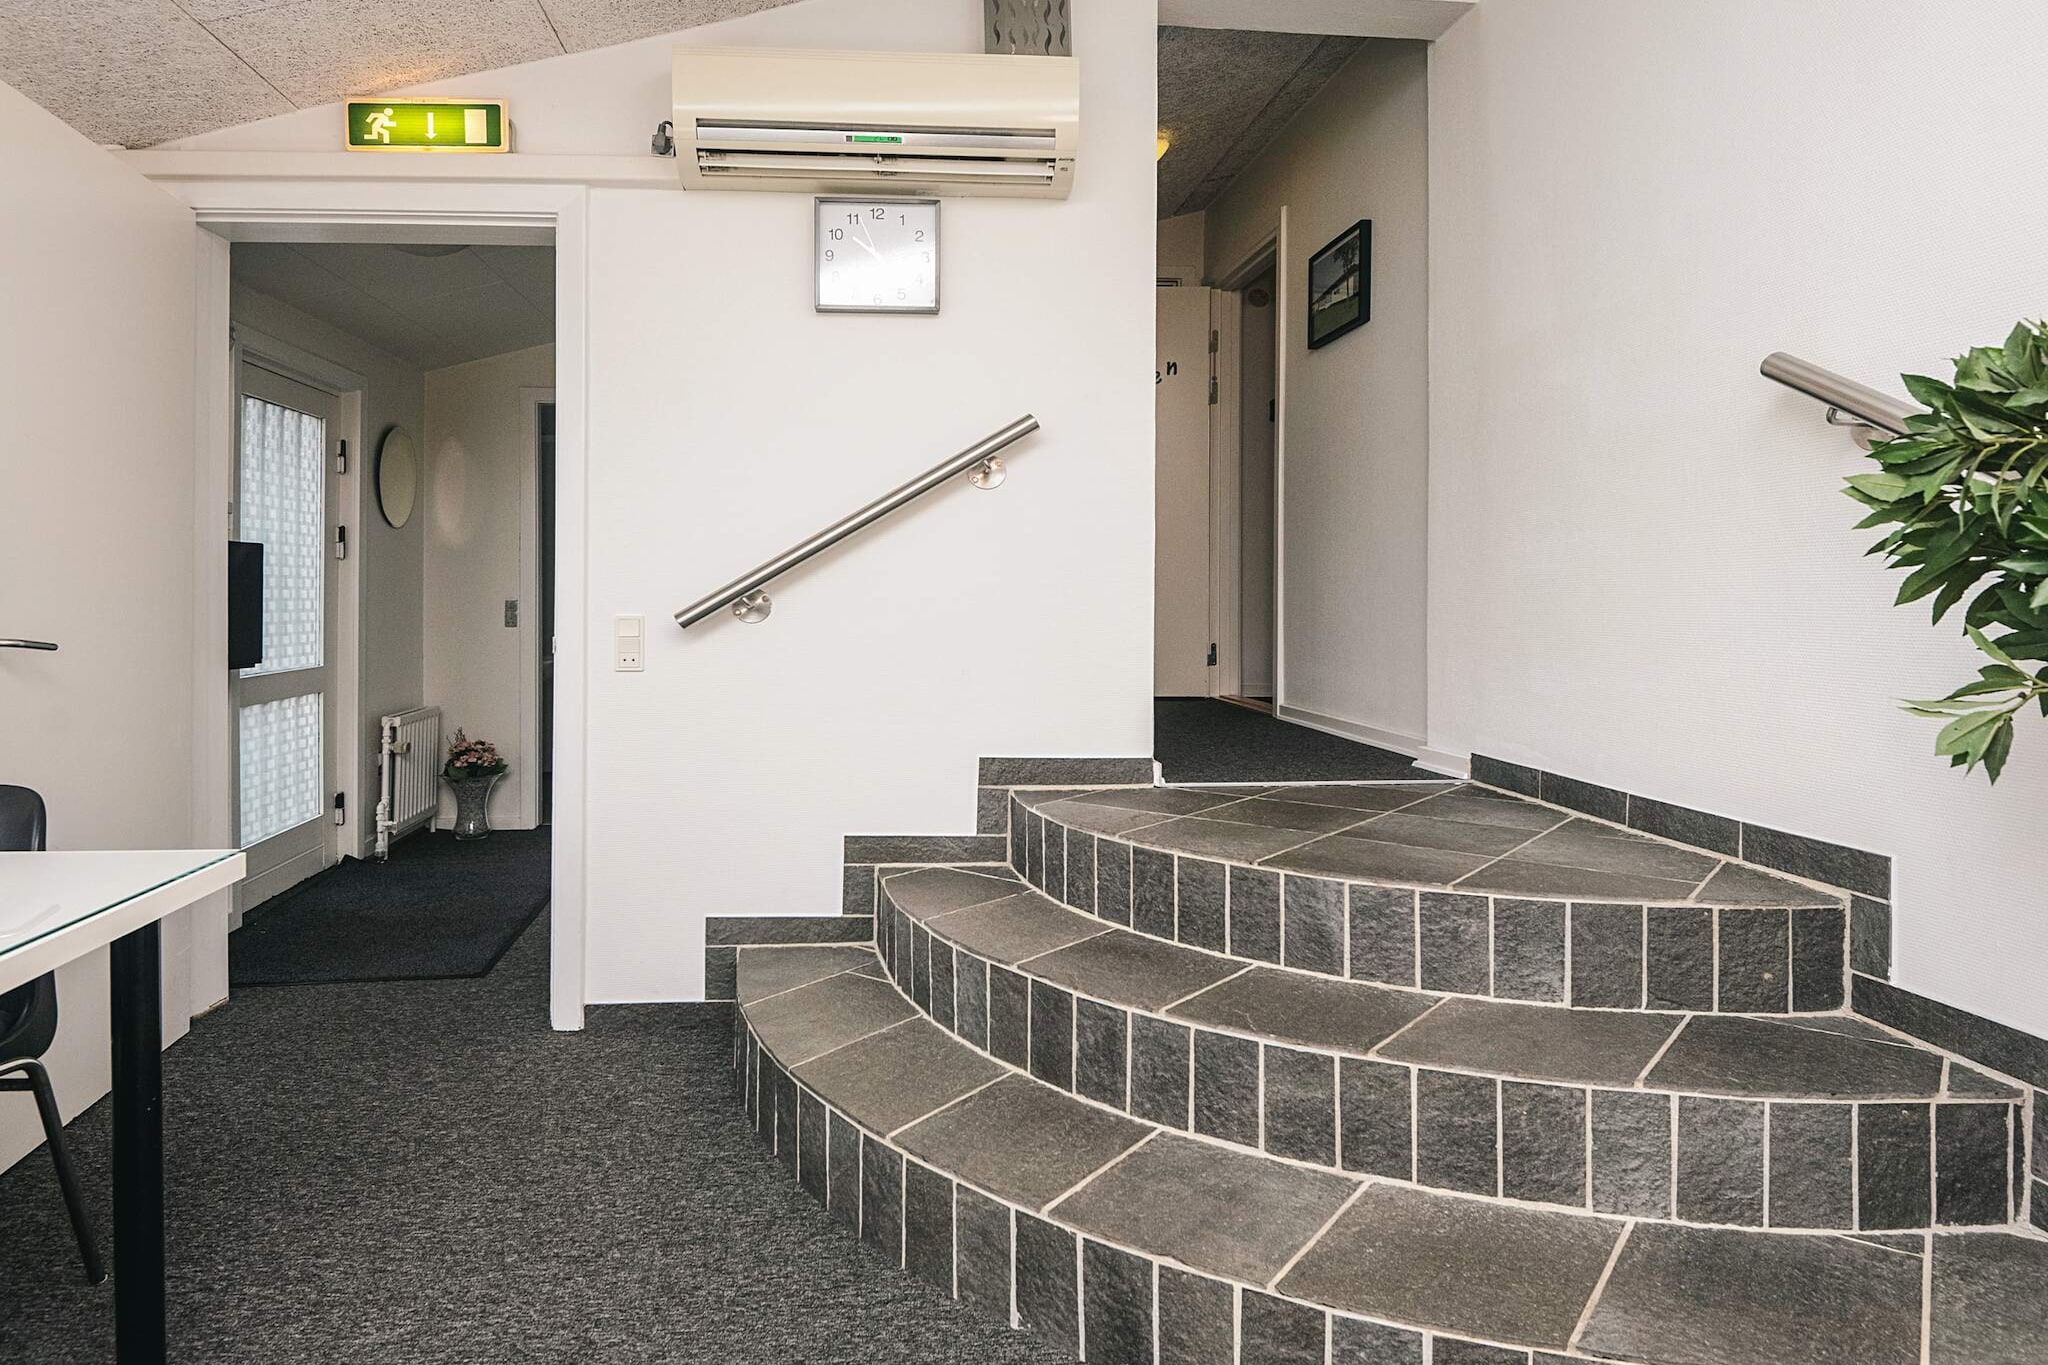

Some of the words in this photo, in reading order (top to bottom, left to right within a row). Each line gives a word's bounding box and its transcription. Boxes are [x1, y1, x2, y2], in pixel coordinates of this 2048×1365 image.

[847, 213, 859, 225] 11
[869, 207, 885, 220] 12
[899, 214, 905, 226] 1
[828, 228, 844, 241] 10
[914, 229, 925, 242] 2
[824, 249, 834, 262] 9
[921, 251, 930, 264] 3
[873, 293, 882, 305] 6
[897, 288, 906, 301] 5
